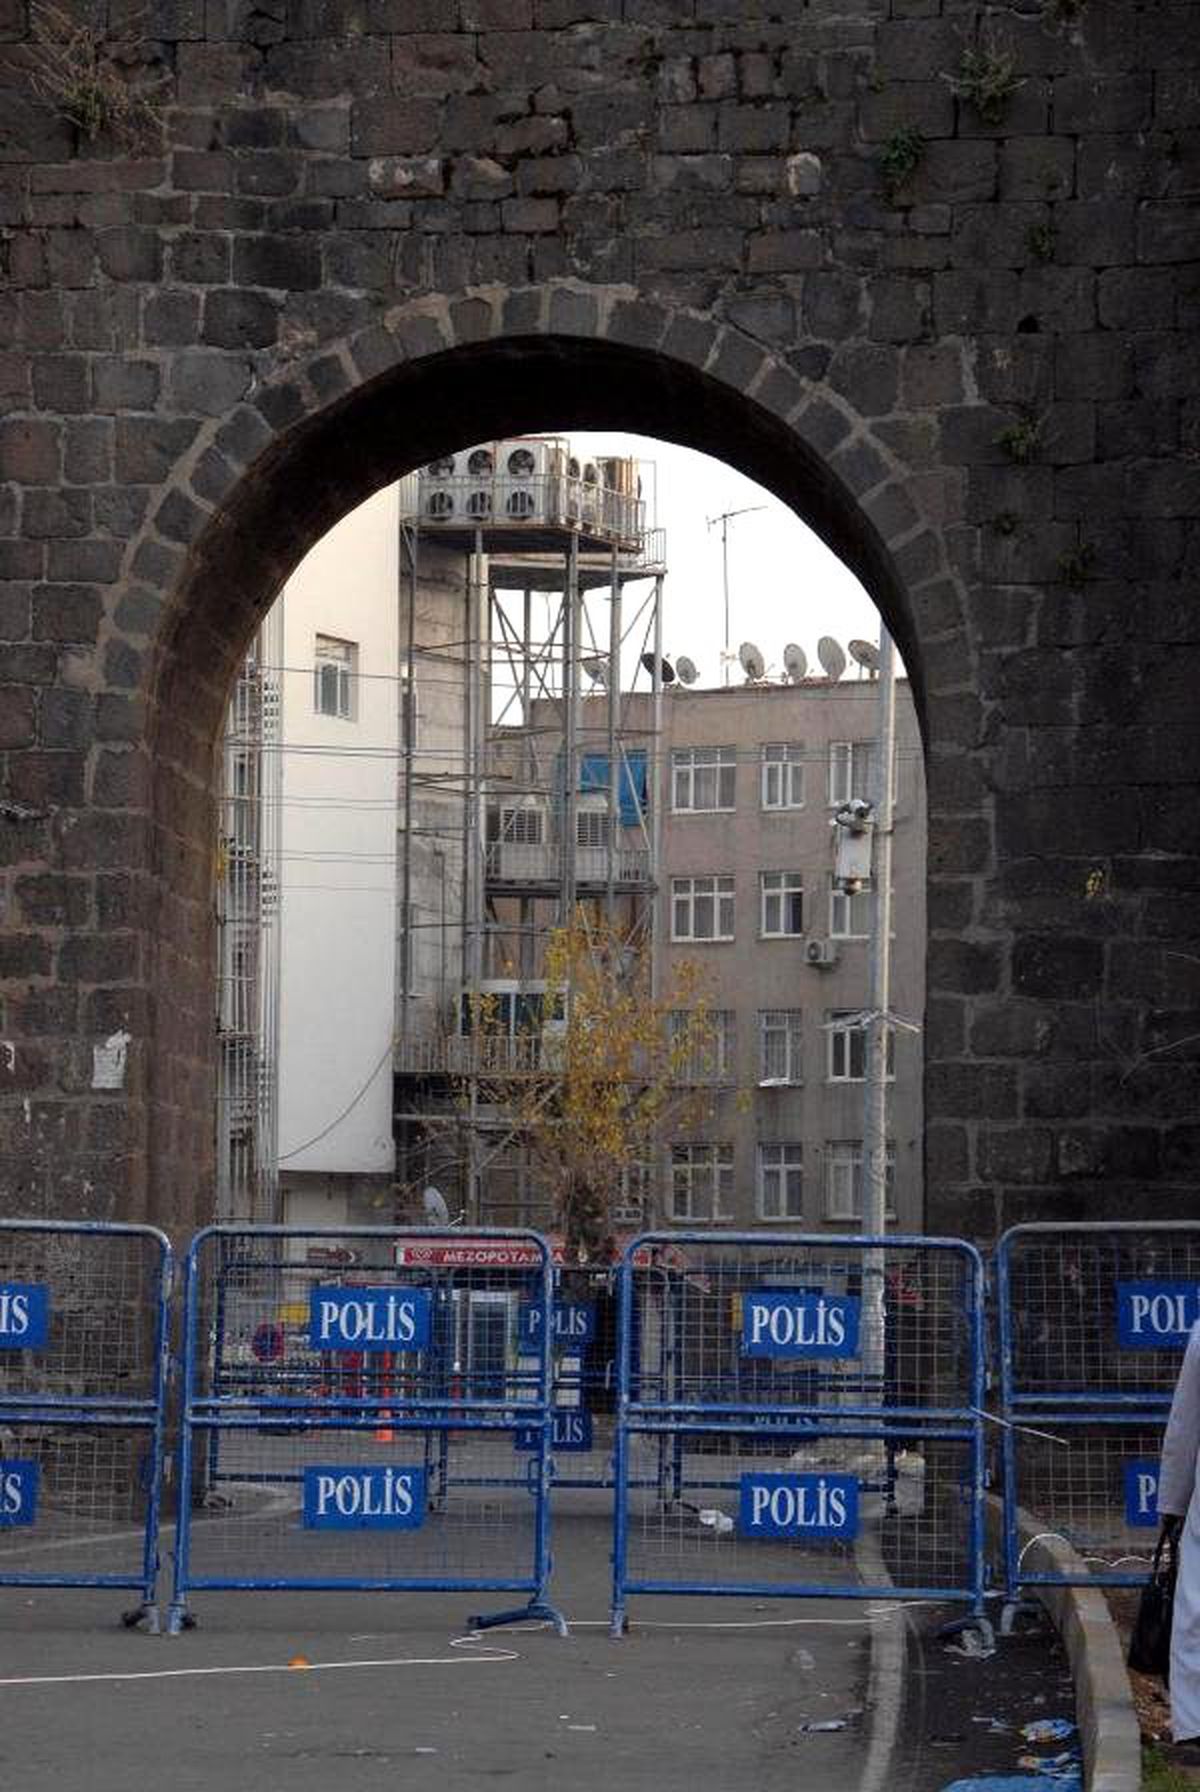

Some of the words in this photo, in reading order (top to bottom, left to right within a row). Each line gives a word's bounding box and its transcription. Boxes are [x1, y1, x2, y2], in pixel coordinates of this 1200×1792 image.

[443, 1250, 564, 1263] MEZOPOTAMA
[319, 1296, 415, 1341] POLİS
[529, 1307, 587, 1335] PLİS
[751, 1299, 846, 1345] POLİS
[317, 1468, 413, 1515] POLİS
[751, 1479, 847, 1526] POLİS
